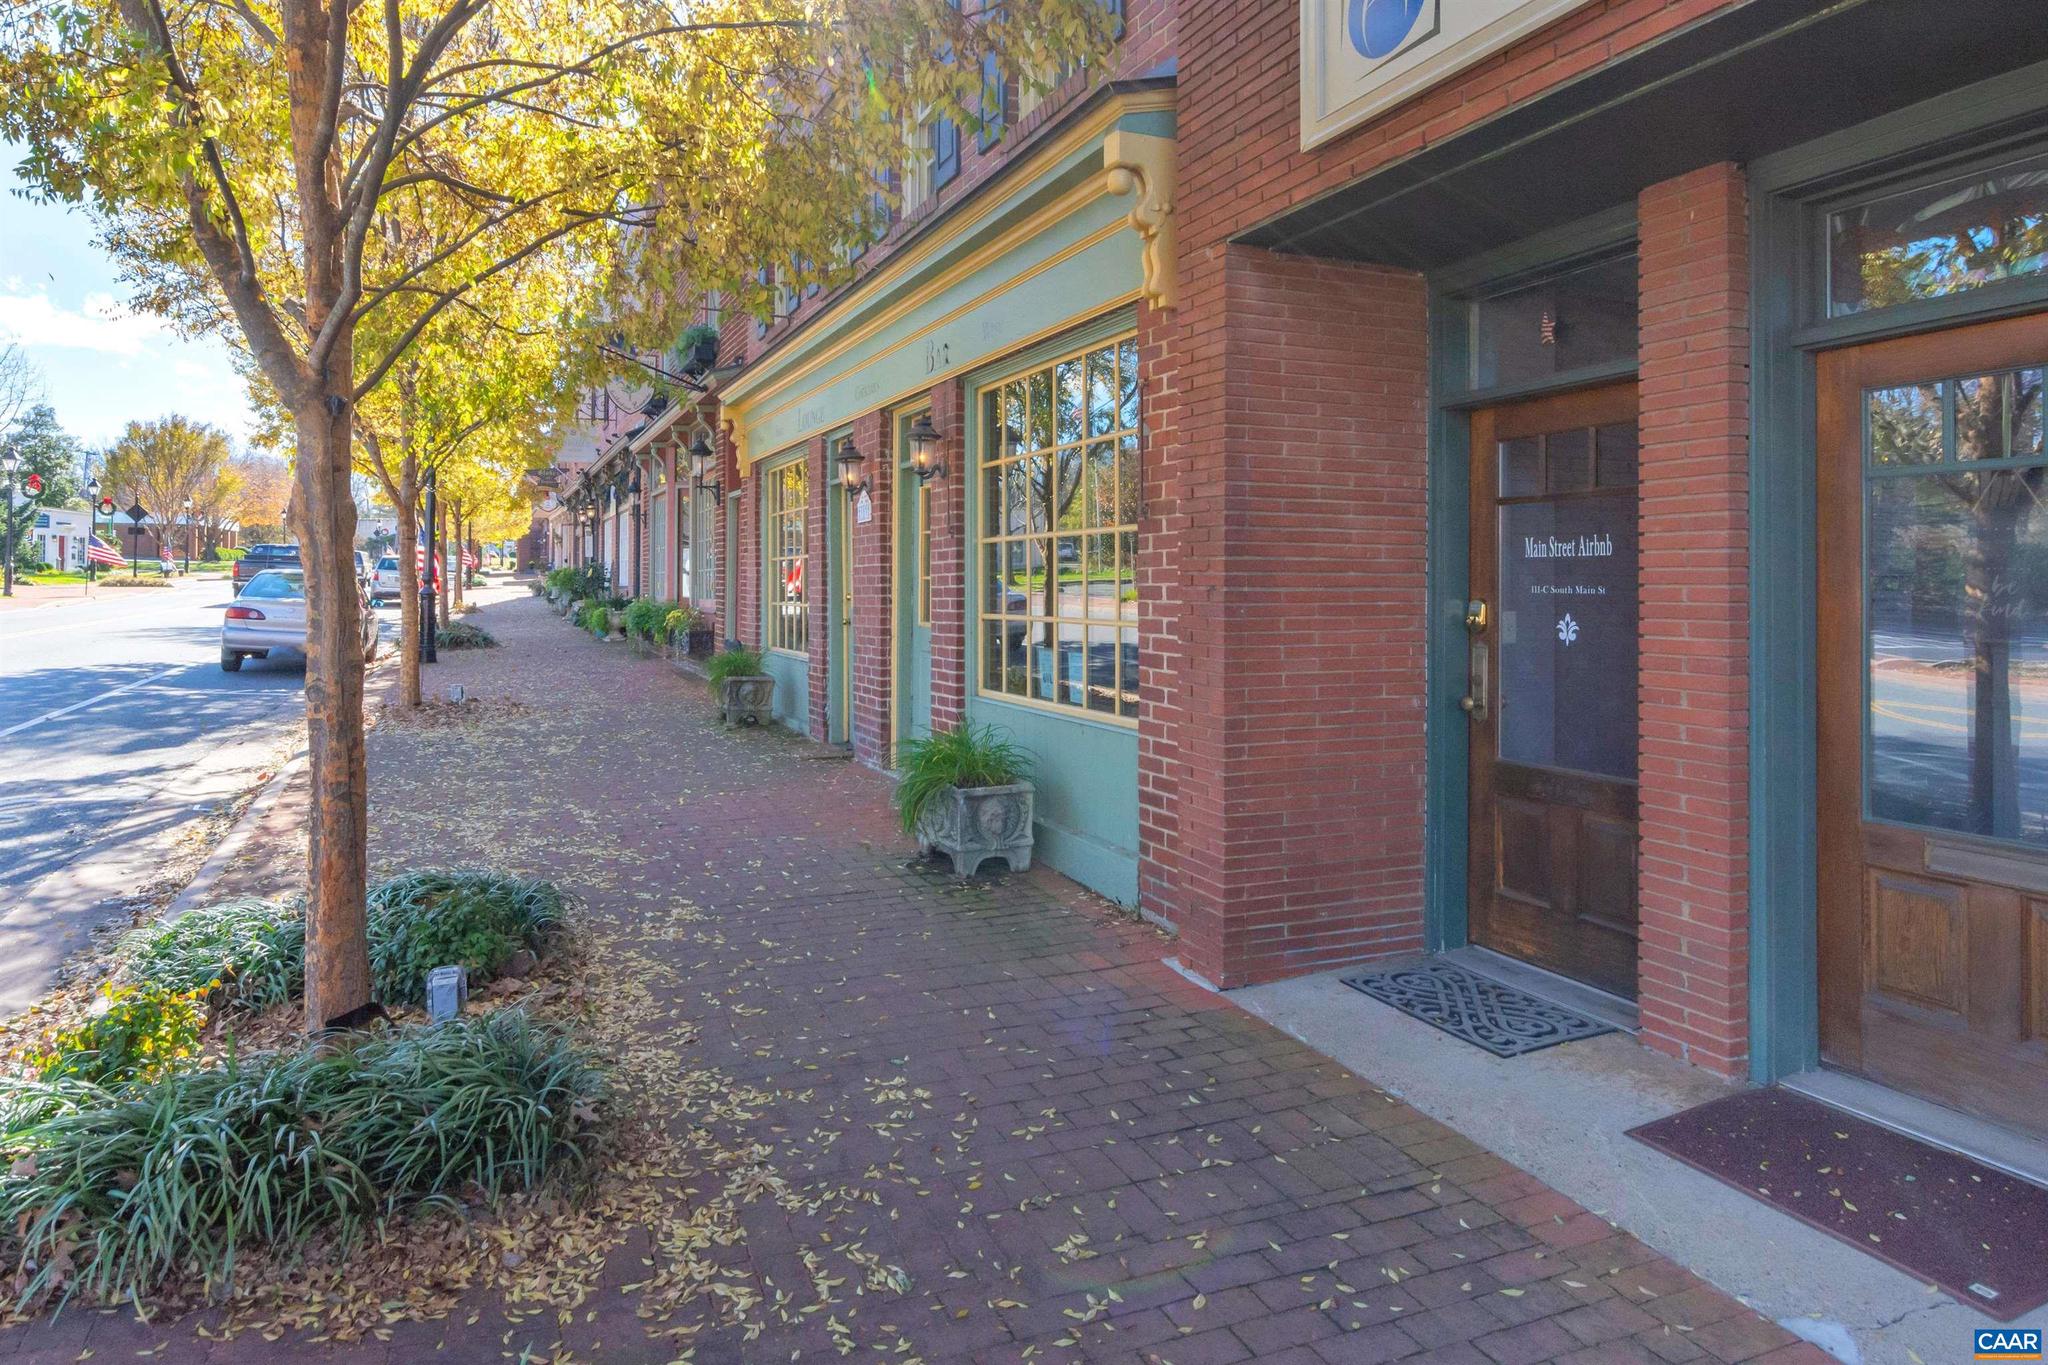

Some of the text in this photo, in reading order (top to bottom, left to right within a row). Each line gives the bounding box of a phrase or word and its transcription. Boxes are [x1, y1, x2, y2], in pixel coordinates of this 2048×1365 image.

[1525, 533, 1613, 558] Main Street Airbnb
[1550, 585, 1573, 595] South
[1575, 585, 1596, 595] Main
[1597, 585, 1606, 595] St
